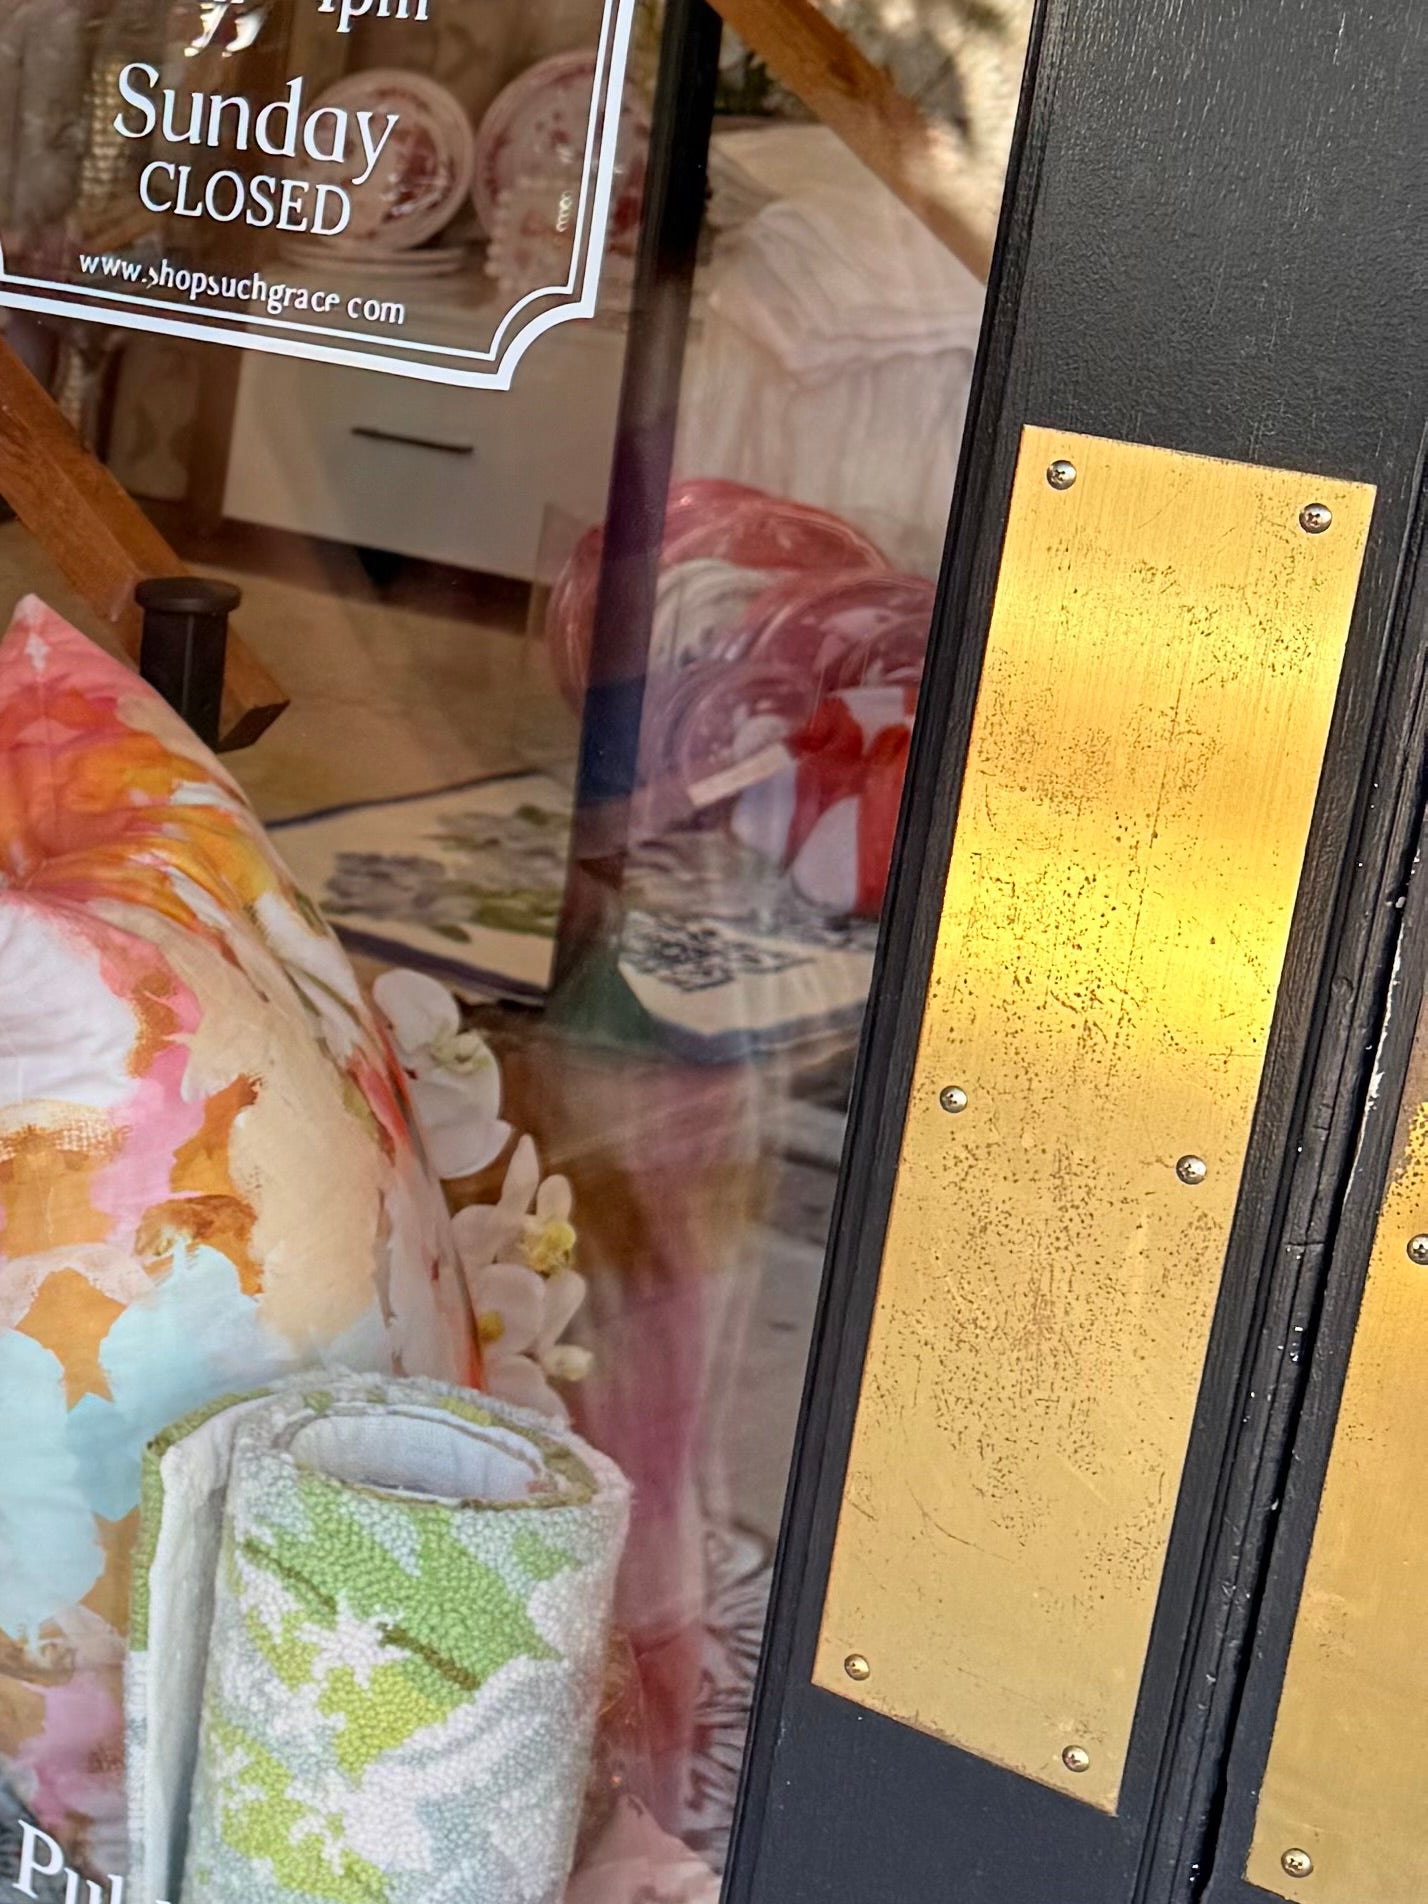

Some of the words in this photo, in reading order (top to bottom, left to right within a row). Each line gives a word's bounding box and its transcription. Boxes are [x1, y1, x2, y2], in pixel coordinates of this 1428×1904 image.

[112, 61, 400, 186] Sunday
[138, 160, 352, 237] CLOSED
[78, 252, 406, 326] www.shopsuchgracecom
